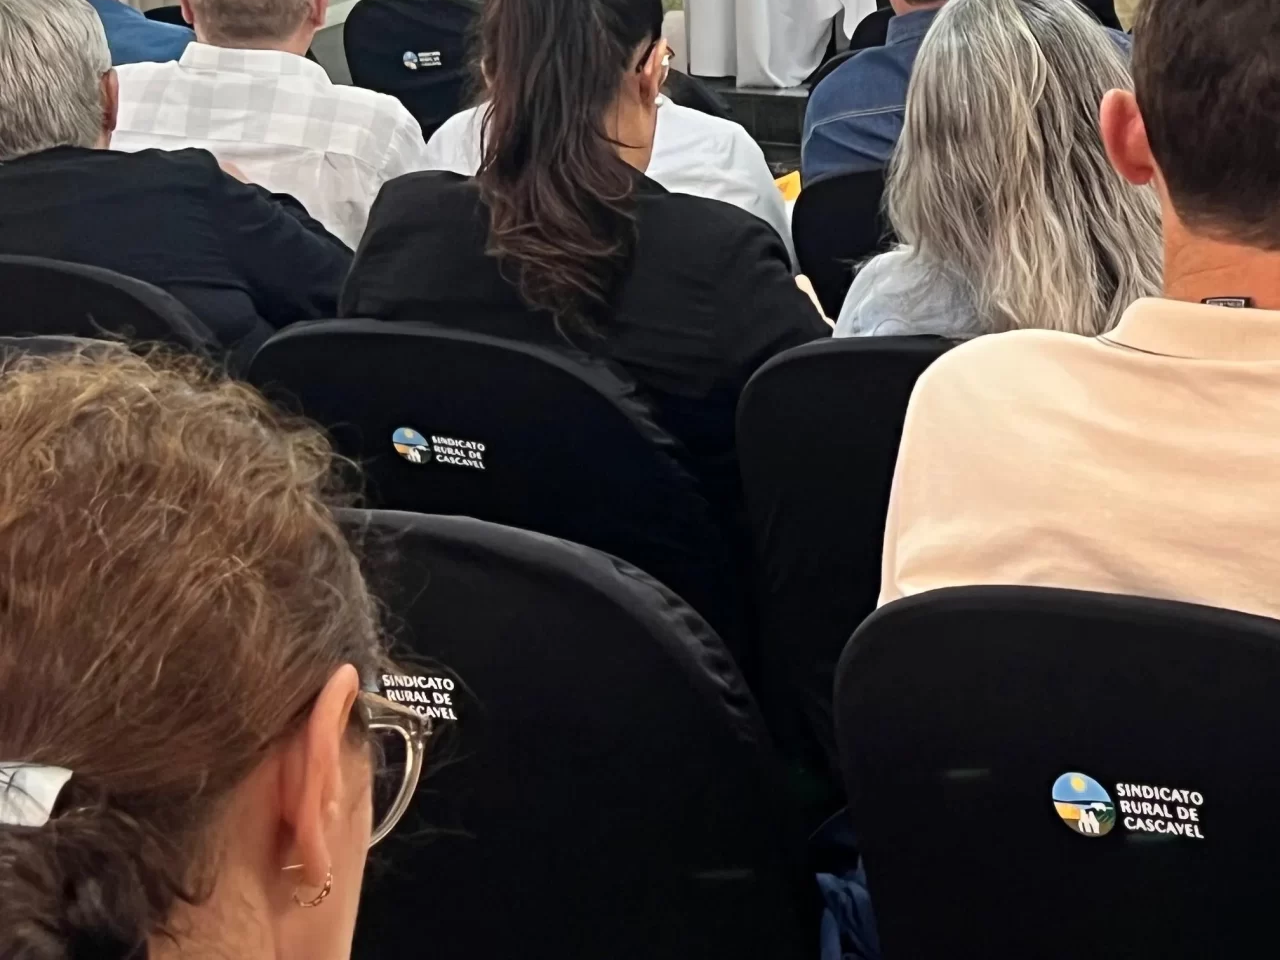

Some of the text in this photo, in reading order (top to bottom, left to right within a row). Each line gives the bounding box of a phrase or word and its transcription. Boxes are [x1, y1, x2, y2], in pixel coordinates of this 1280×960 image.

[431, 435, 485, 451] SINDICATO
[433, 445, 482, 460] RURAL DE
[436, 454, 485, 470] CASCAVEL
[382, 674, 455, 691] SINDICATO
[386, 689, 453, 706] RURAL DE
[409, 705, 458, 720] SCAVEL
[1116, 783, 1204, 806] SINDICATO
[1119, 800, 1199, 822] RURAL DE
[1124, 817, 1205, 839] CASCAVEL
